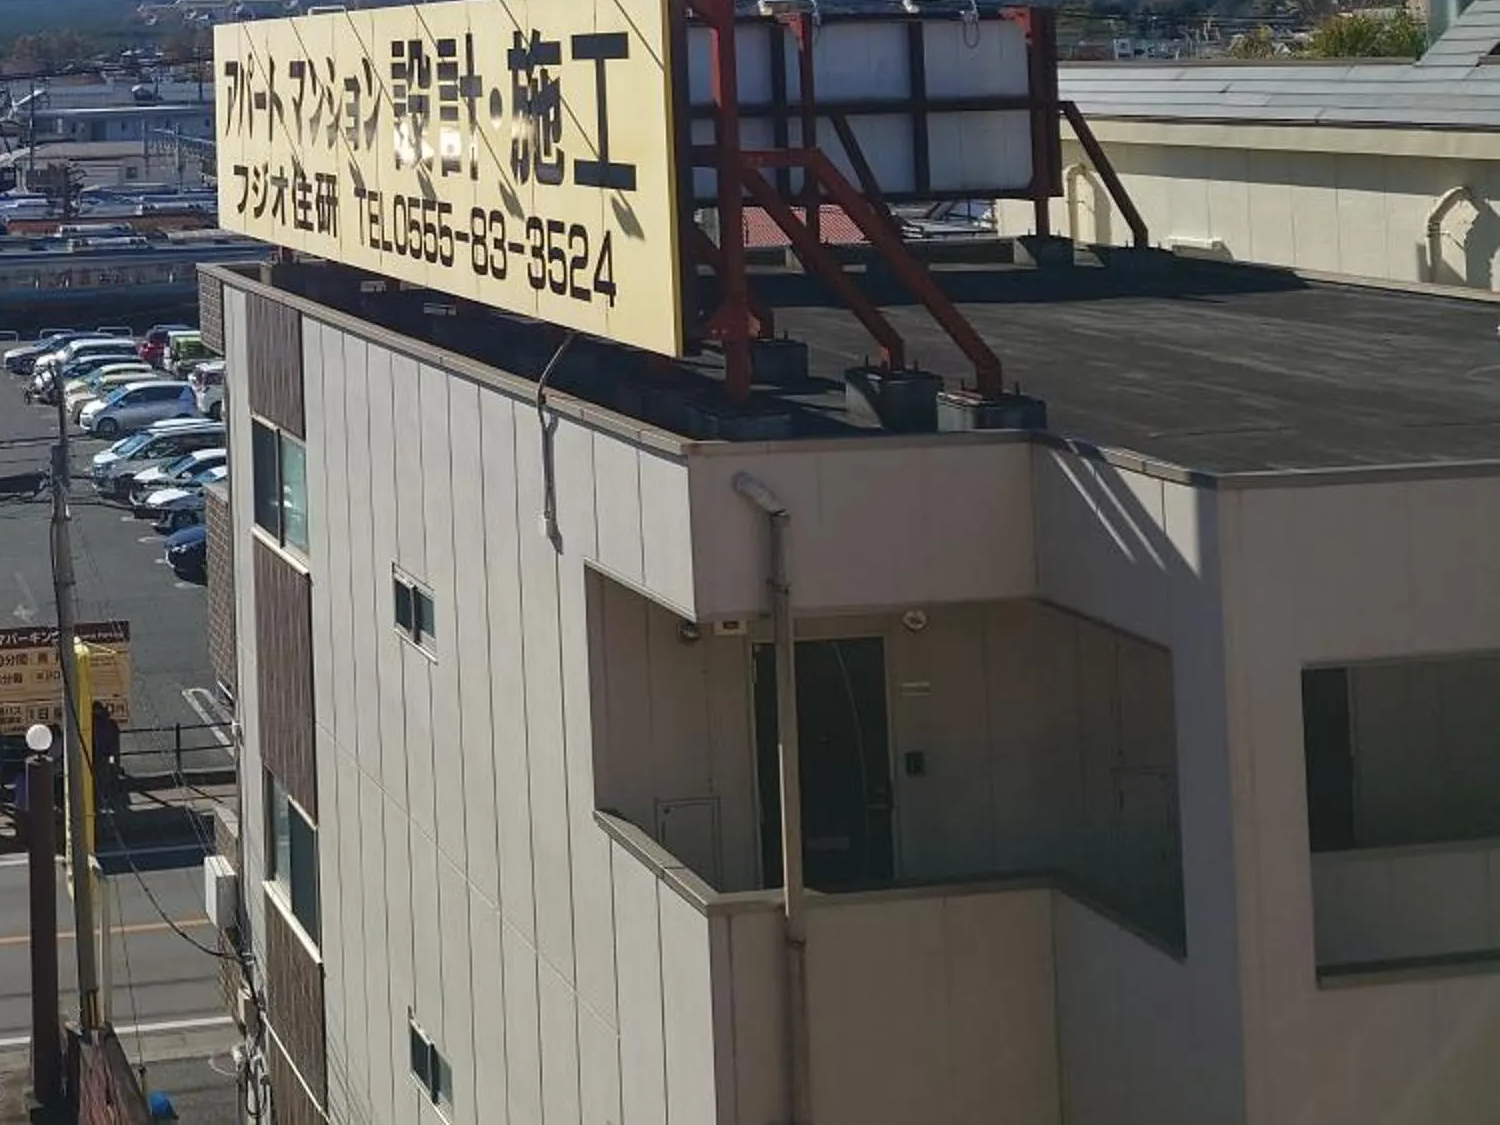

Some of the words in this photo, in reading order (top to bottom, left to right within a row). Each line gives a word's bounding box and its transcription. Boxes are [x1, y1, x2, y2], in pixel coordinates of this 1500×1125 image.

[232, 158, 339, 238] フジオ住研
